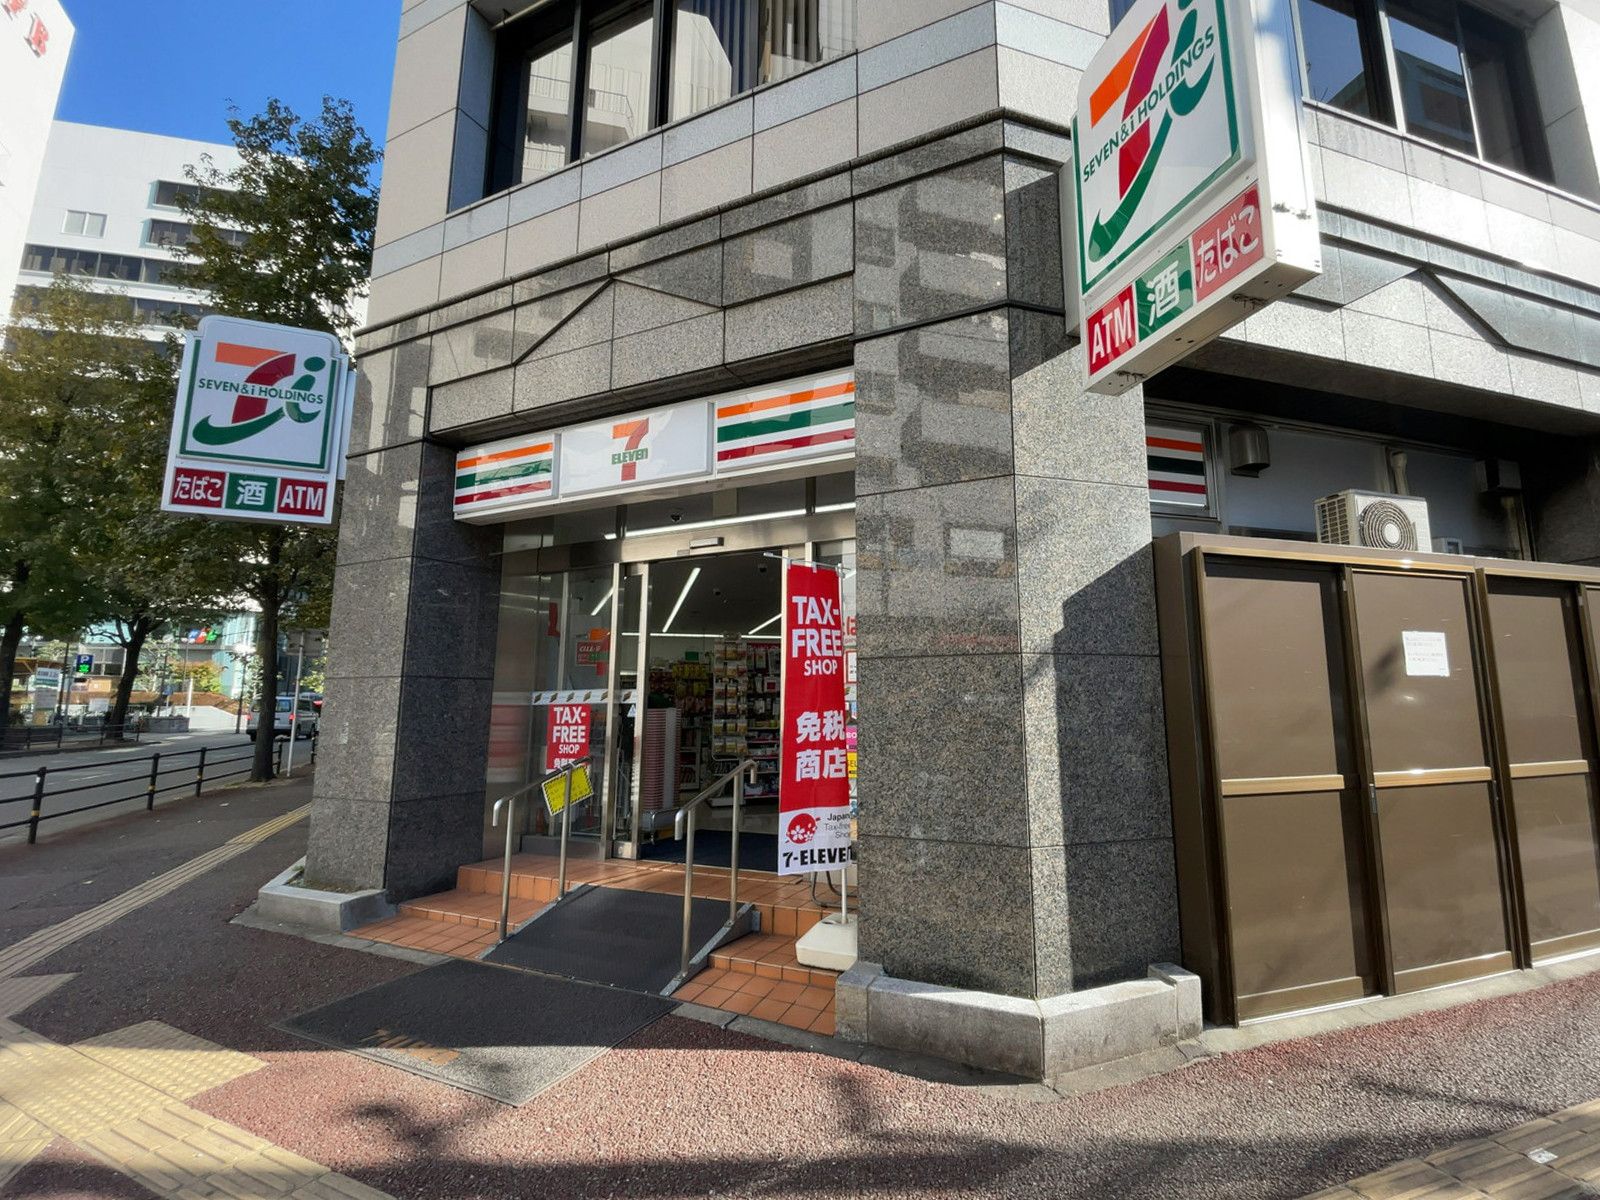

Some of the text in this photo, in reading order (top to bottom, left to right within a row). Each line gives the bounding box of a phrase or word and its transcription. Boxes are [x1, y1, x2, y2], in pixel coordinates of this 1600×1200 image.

[1138, 26, 1215, 124] HOLDINGS
[1197, 205, 1259, 288] たばこ
[1146, 260, 1180, 327] 酒
[1092, 299, 1132, 364] ATM
[258, 385, 324, 404] HOLDINGS
[174, 474, 222, 501] たばこ
[235, 479, 268, 506] 酒
[280, 485, 324, 511] ATM
[792, 596, 840, 626] TAX-
[792, 628, 843, 658] FREE
[803, 659, 838, 676] SHOP
[553, 706, 587, 724] TAX-
[796, 710, 845, 743] 免税
[552, 725, 586, 743] FREE
[558, 744, 580, 754] SHOP
[796, 747, 847, 782] 商店
[827, 813, 851, 823] Japan
